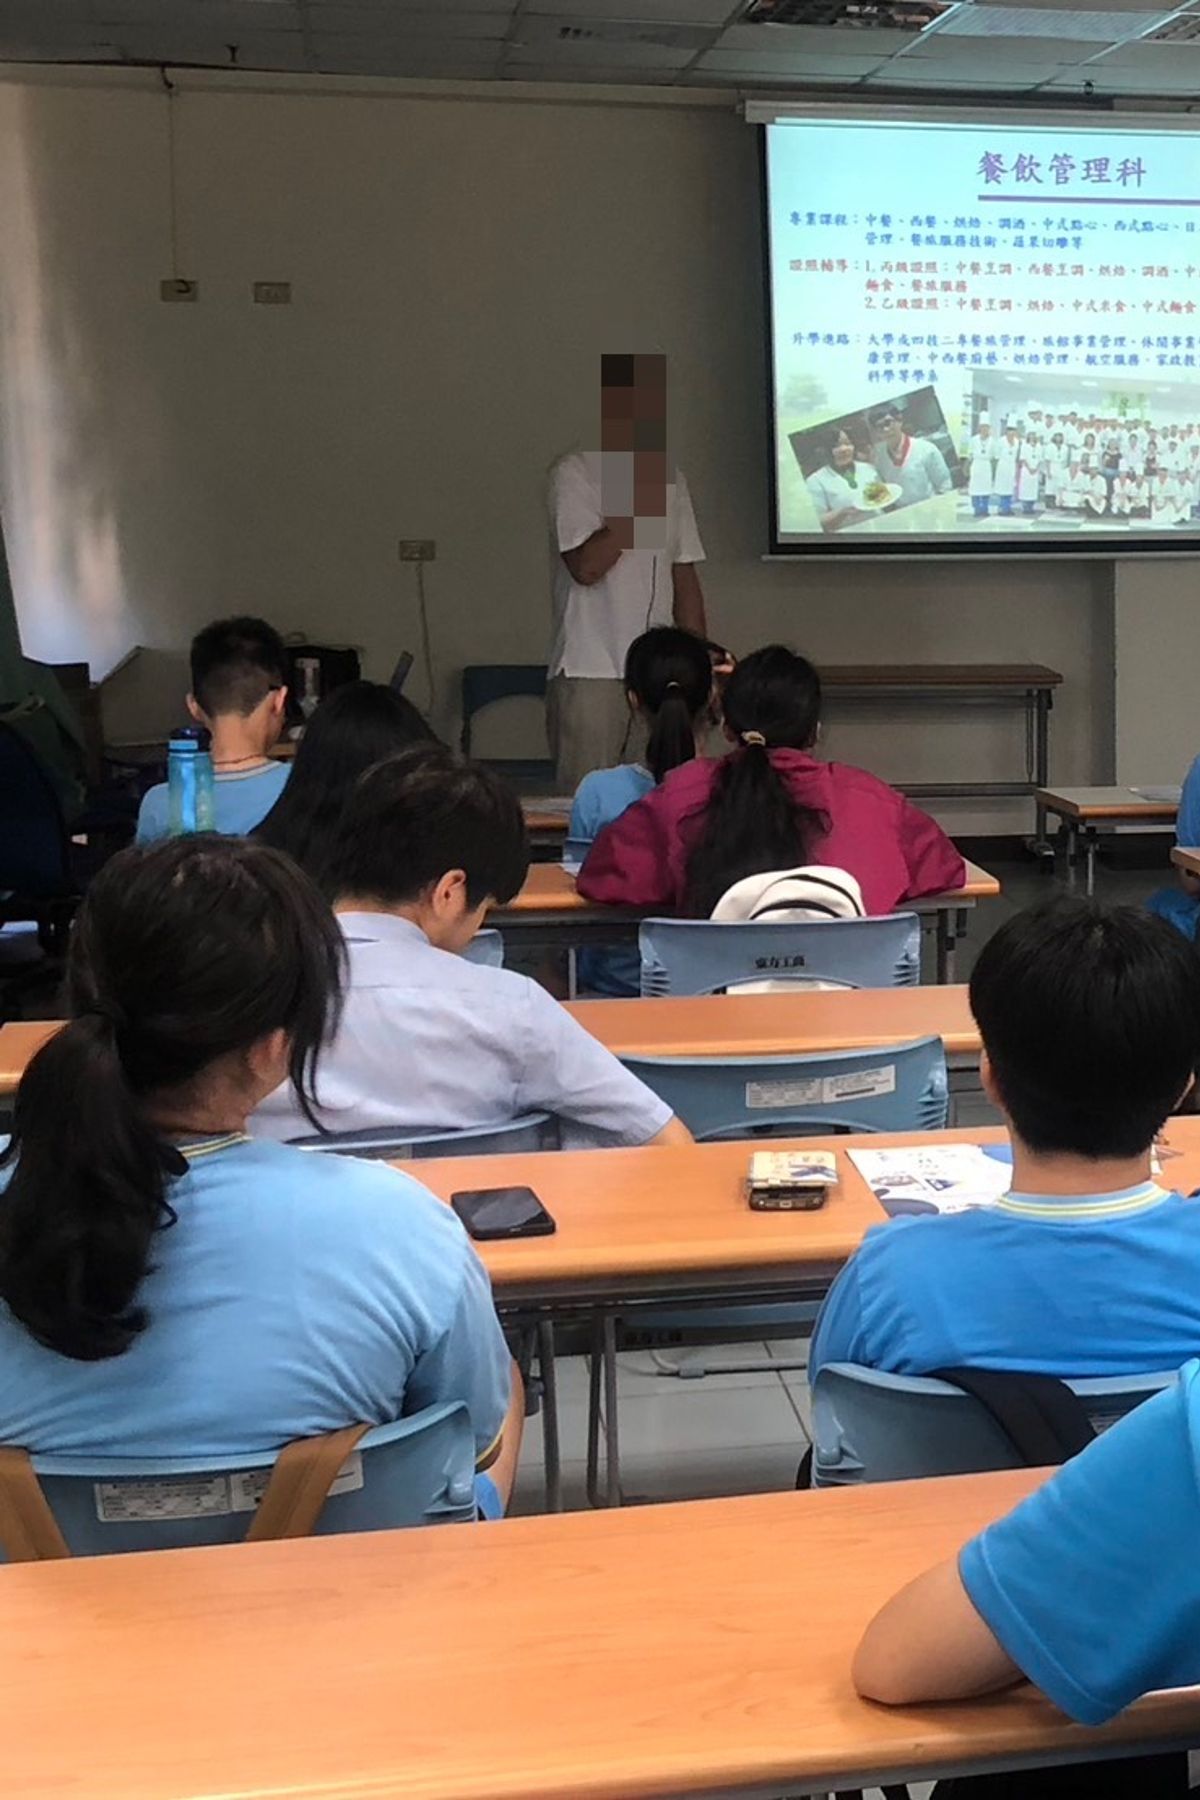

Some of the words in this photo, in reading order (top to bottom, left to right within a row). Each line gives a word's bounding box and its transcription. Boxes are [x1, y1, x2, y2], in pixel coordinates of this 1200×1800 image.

[977, 151, 1146, 187] 餐飲管理科
